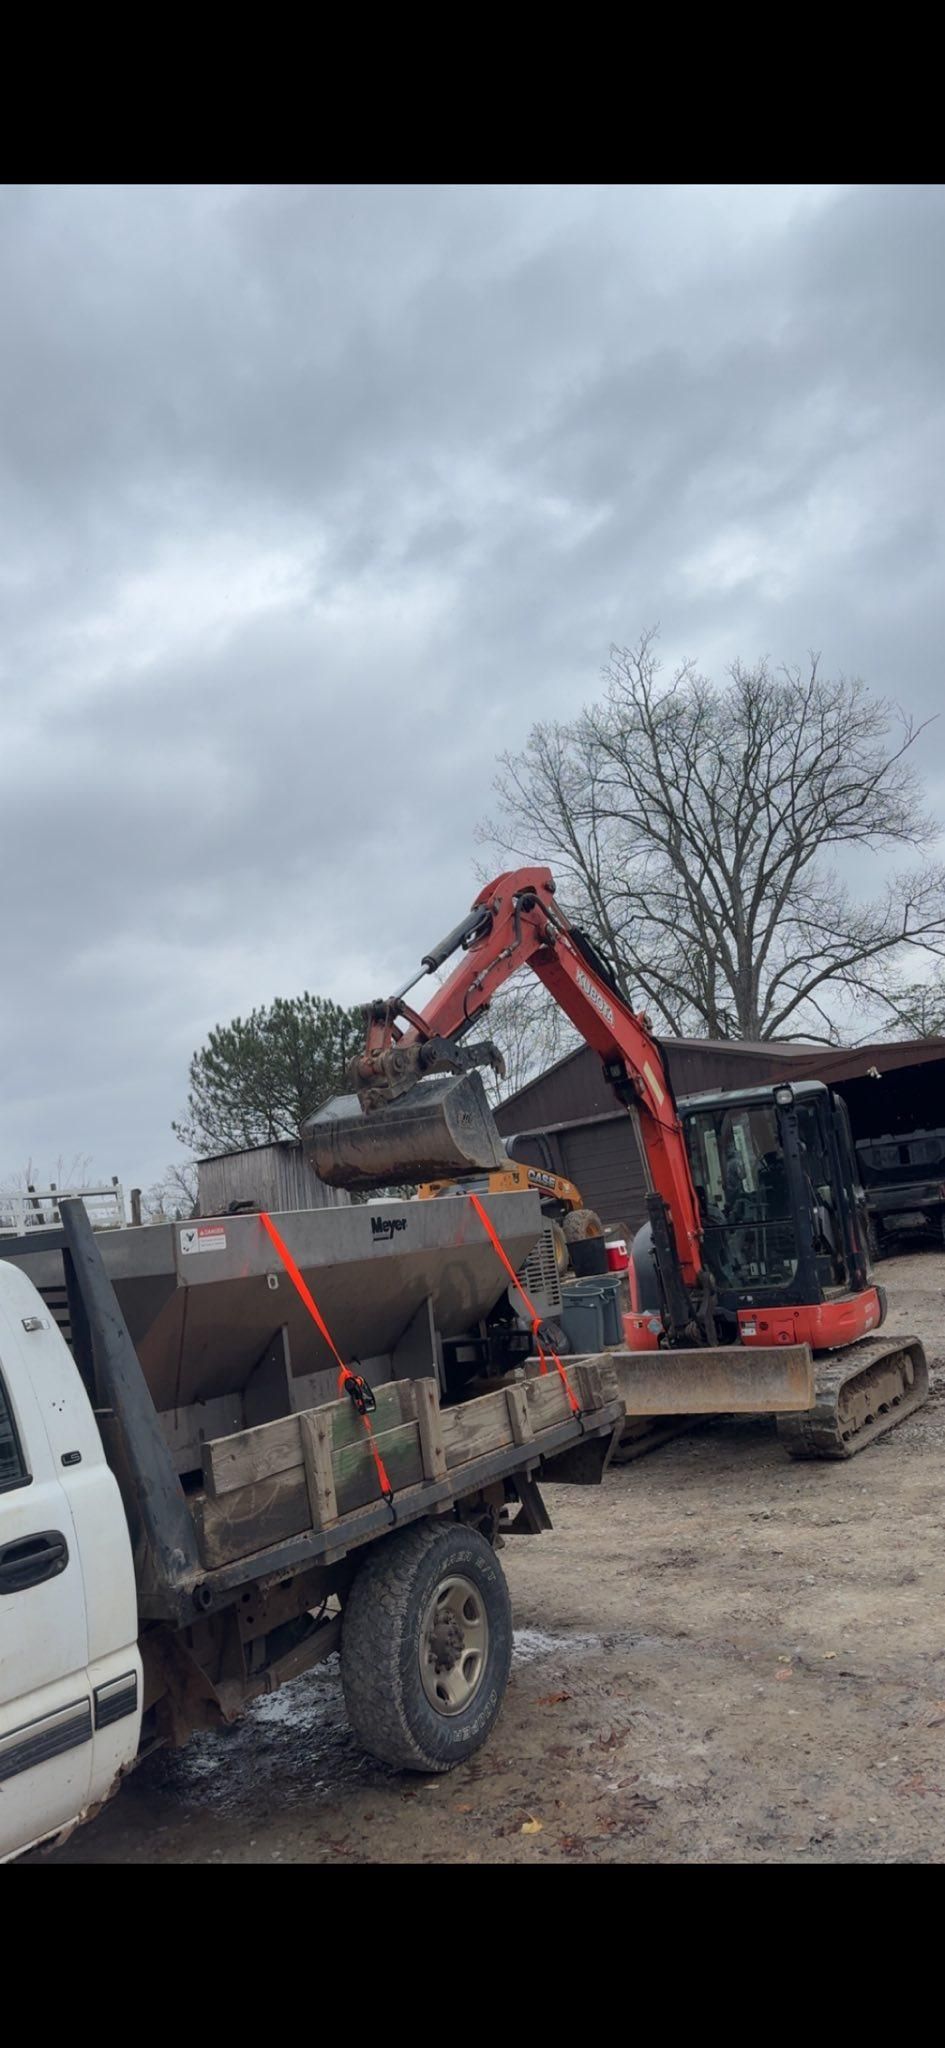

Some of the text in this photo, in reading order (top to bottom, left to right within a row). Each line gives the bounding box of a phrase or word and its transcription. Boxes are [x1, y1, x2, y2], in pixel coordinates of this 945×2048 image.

[576, 966, 614, 1027] KUBOTA
[527, 1169, 556, 1188] CASE
[370, 1216, 407, 1241] Meyer
[62, 1453, 80, 1464] LS
